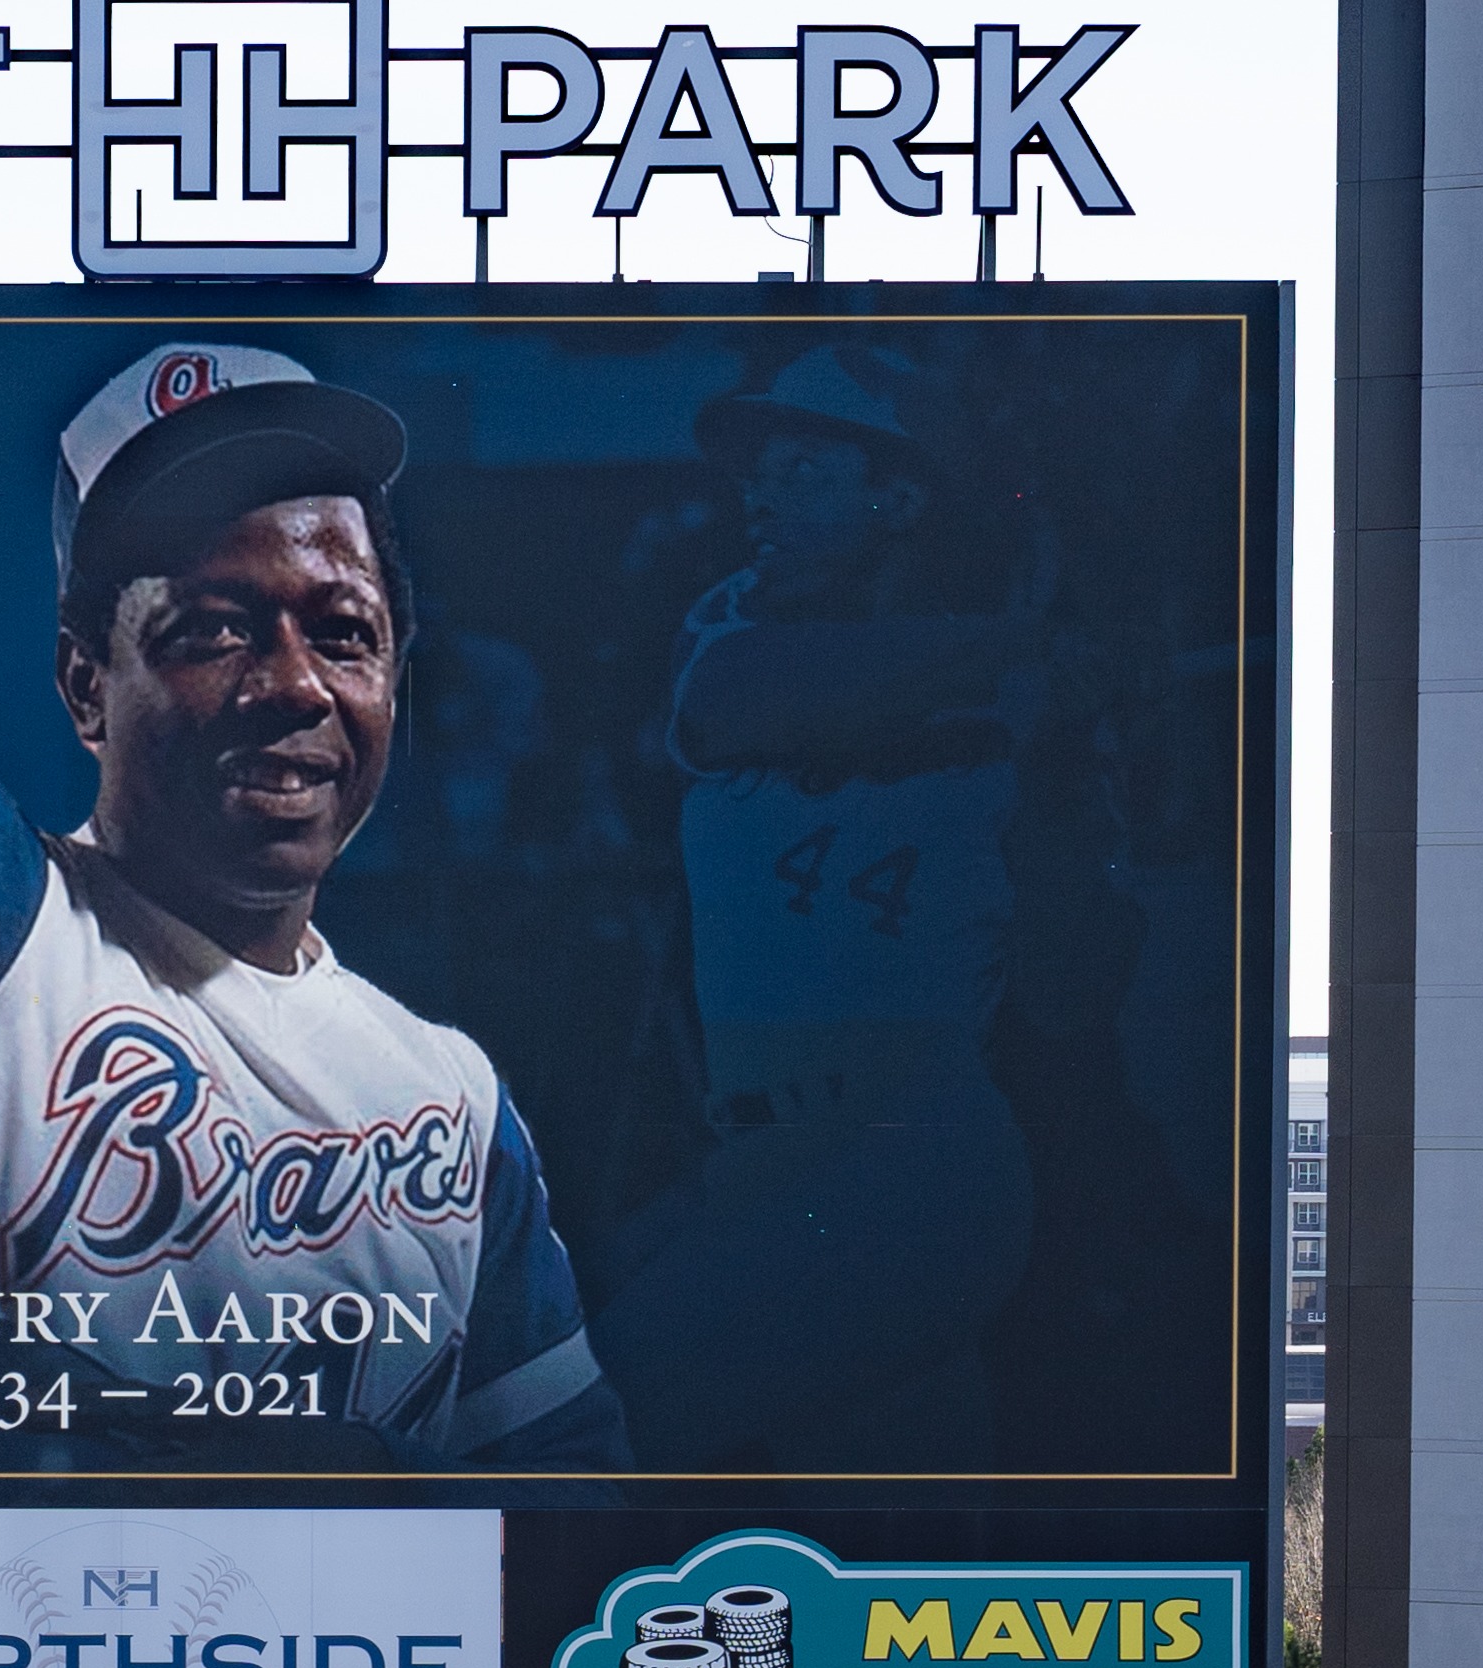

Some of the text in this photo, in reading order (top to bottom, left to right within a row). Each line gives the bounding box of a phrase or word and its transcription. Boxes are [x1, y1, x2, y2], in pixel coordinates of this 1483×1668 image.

[460, 23, 1140, 219] PARK
[136, 1269, 439, 1345] AARON
[171, 1371, 327, 1417] 2021
[862, 1597, 1204, 1663] MAVIS
